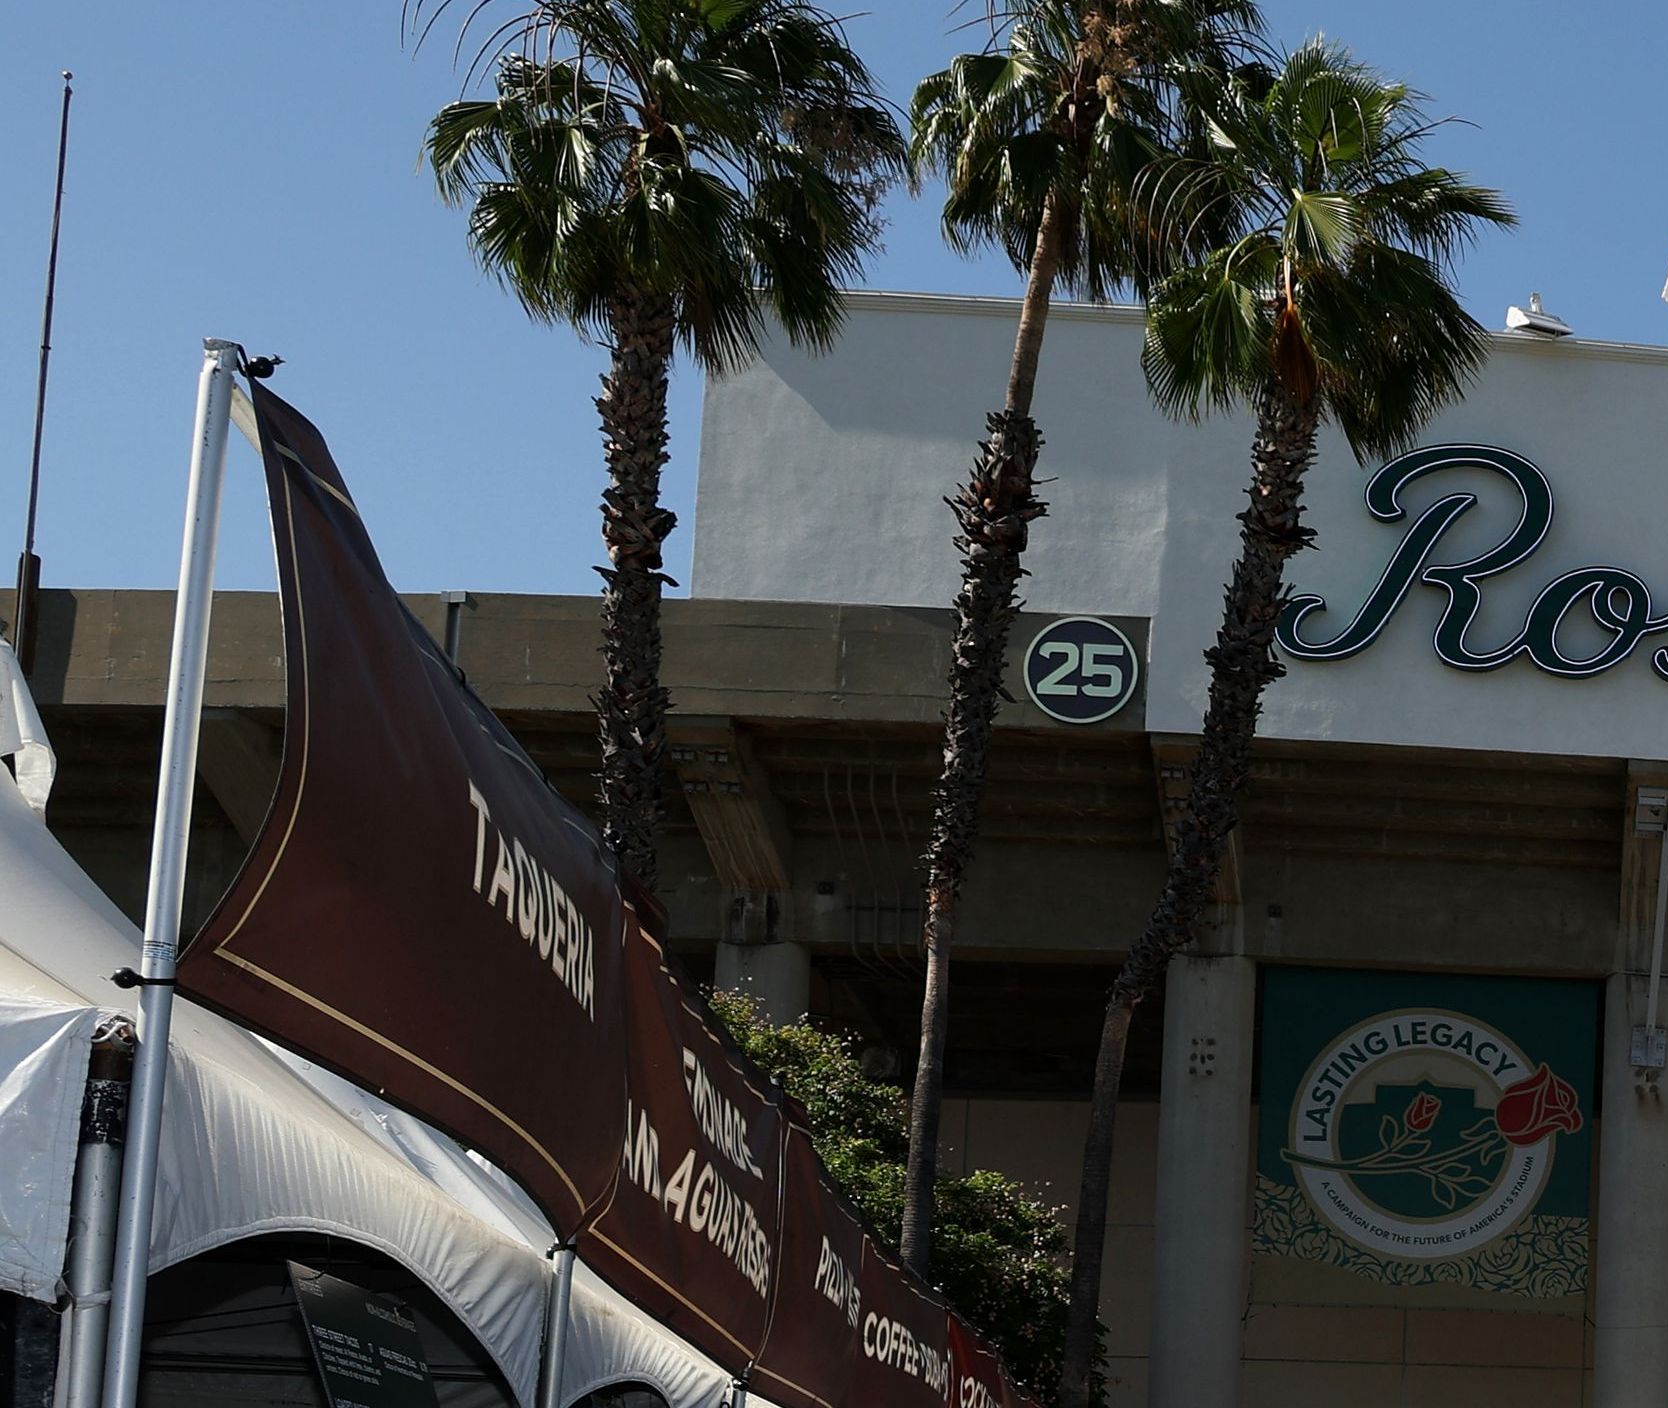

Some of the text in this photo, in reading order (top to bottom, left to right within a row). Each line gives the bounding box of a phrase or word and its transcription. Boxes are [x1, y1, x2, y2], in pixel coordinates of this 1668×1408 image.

[1036, 641, 1124, 697] 25
[469, 778, 594, 1022] TAQUERIA
[683, 1046, 763, 1181] EMONADE
[1303, 1021, 1517, 1142] LASTING LEGACY
[664, 1148, 740, 1258] AGUAS
[1327, 1187, 1370, 1231] CAMPAIGN
[1369, 1224, 1390, 1240] FOR
[1391, 1232, 1412, 1245] THE
[1413, 1233, 1452, 1246] FUTURE
[1453, 1229, 1468, 1243] OF
[1469, 1194, 1515, 1236] AMERICA'S
[1510, 1155, 1534, 1200] STADIUM
[863, 1311, 918, 1377] COFFEE
